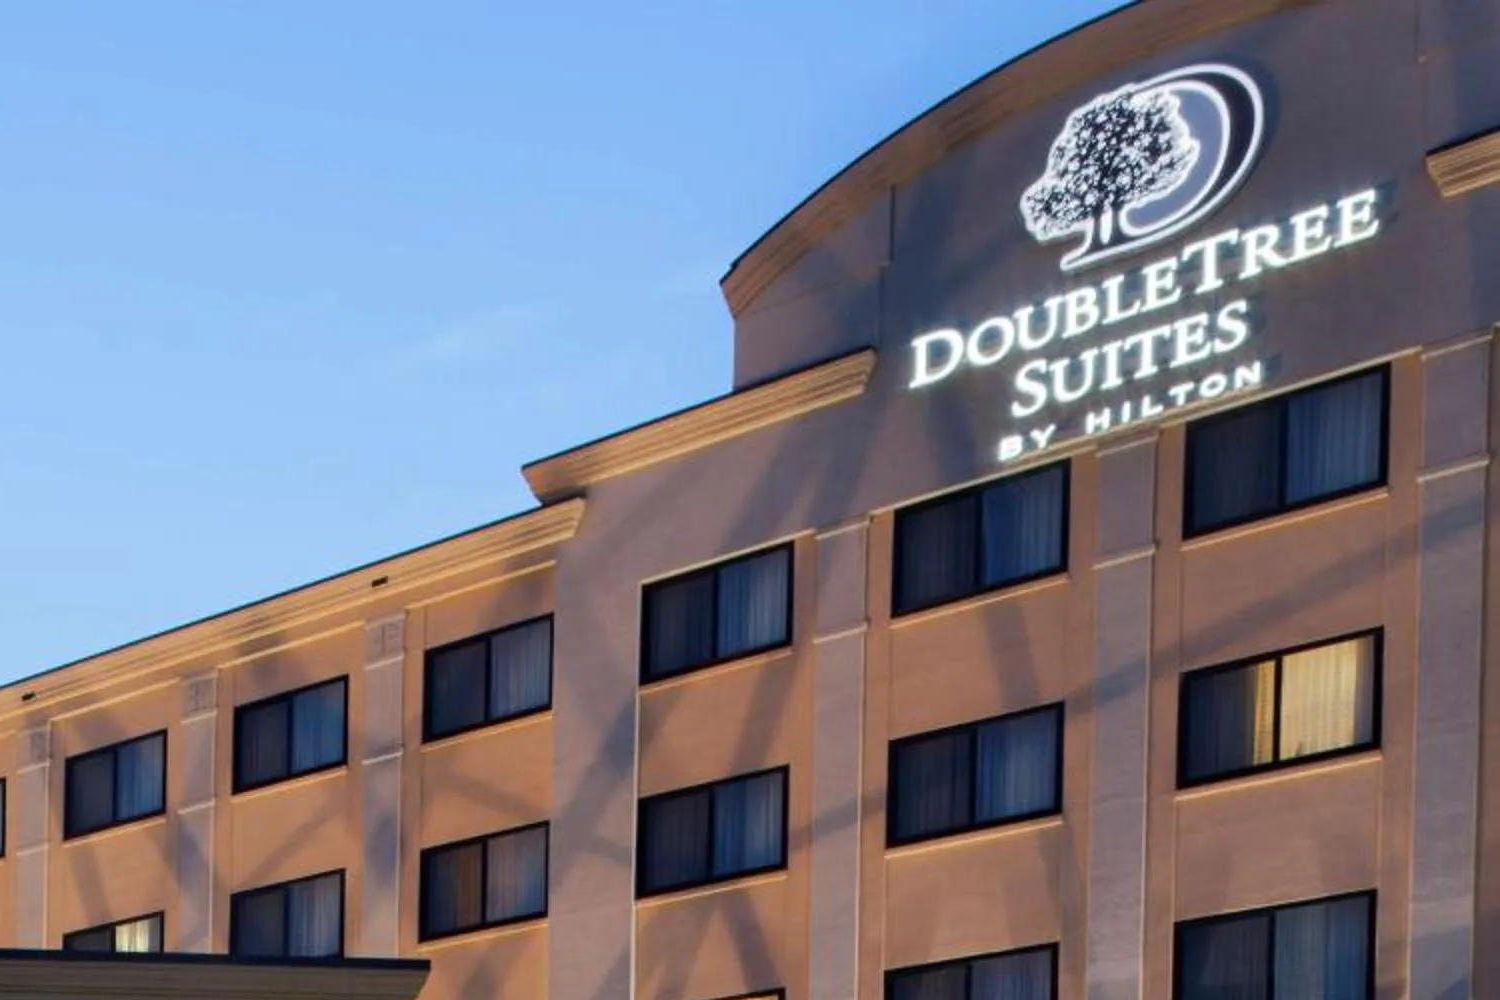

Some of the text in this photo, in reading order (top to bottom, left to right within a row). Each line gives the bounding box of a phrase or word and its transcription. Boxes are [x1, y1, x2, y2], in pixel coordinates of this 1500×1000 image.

[908, 188, 1380, 389] DOUBLETREE
[997, 359, 1262, 461] BY HILTON
[1011, 299, 1249, 418] SUITES
